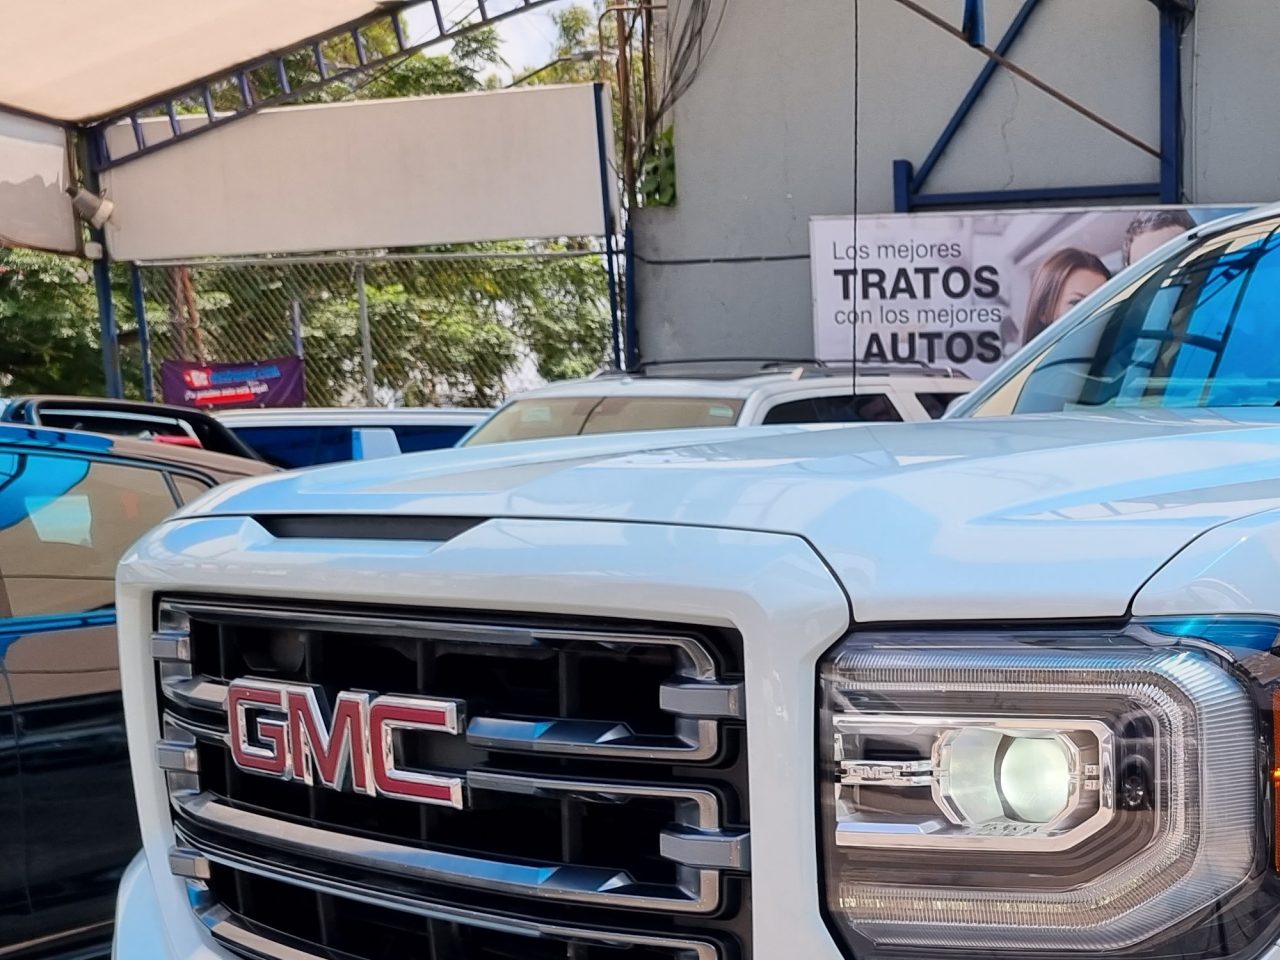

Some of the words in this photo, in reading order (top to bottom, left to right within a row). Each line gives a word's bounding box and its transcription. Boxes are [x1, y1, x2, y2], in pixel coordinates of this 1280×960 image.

[832, 241, 870, 260] Los
[877, 240, 962, 263] mejores
[833, 264, 1001, 301] TRATOS
[834, 308, 872, 325] con
[879, 305, 910, 323] los
[917, 304, 1002, 329] mejores
[862, 330, 1002, 364] AUTOS
[227, 677, 463, 811] GMC
